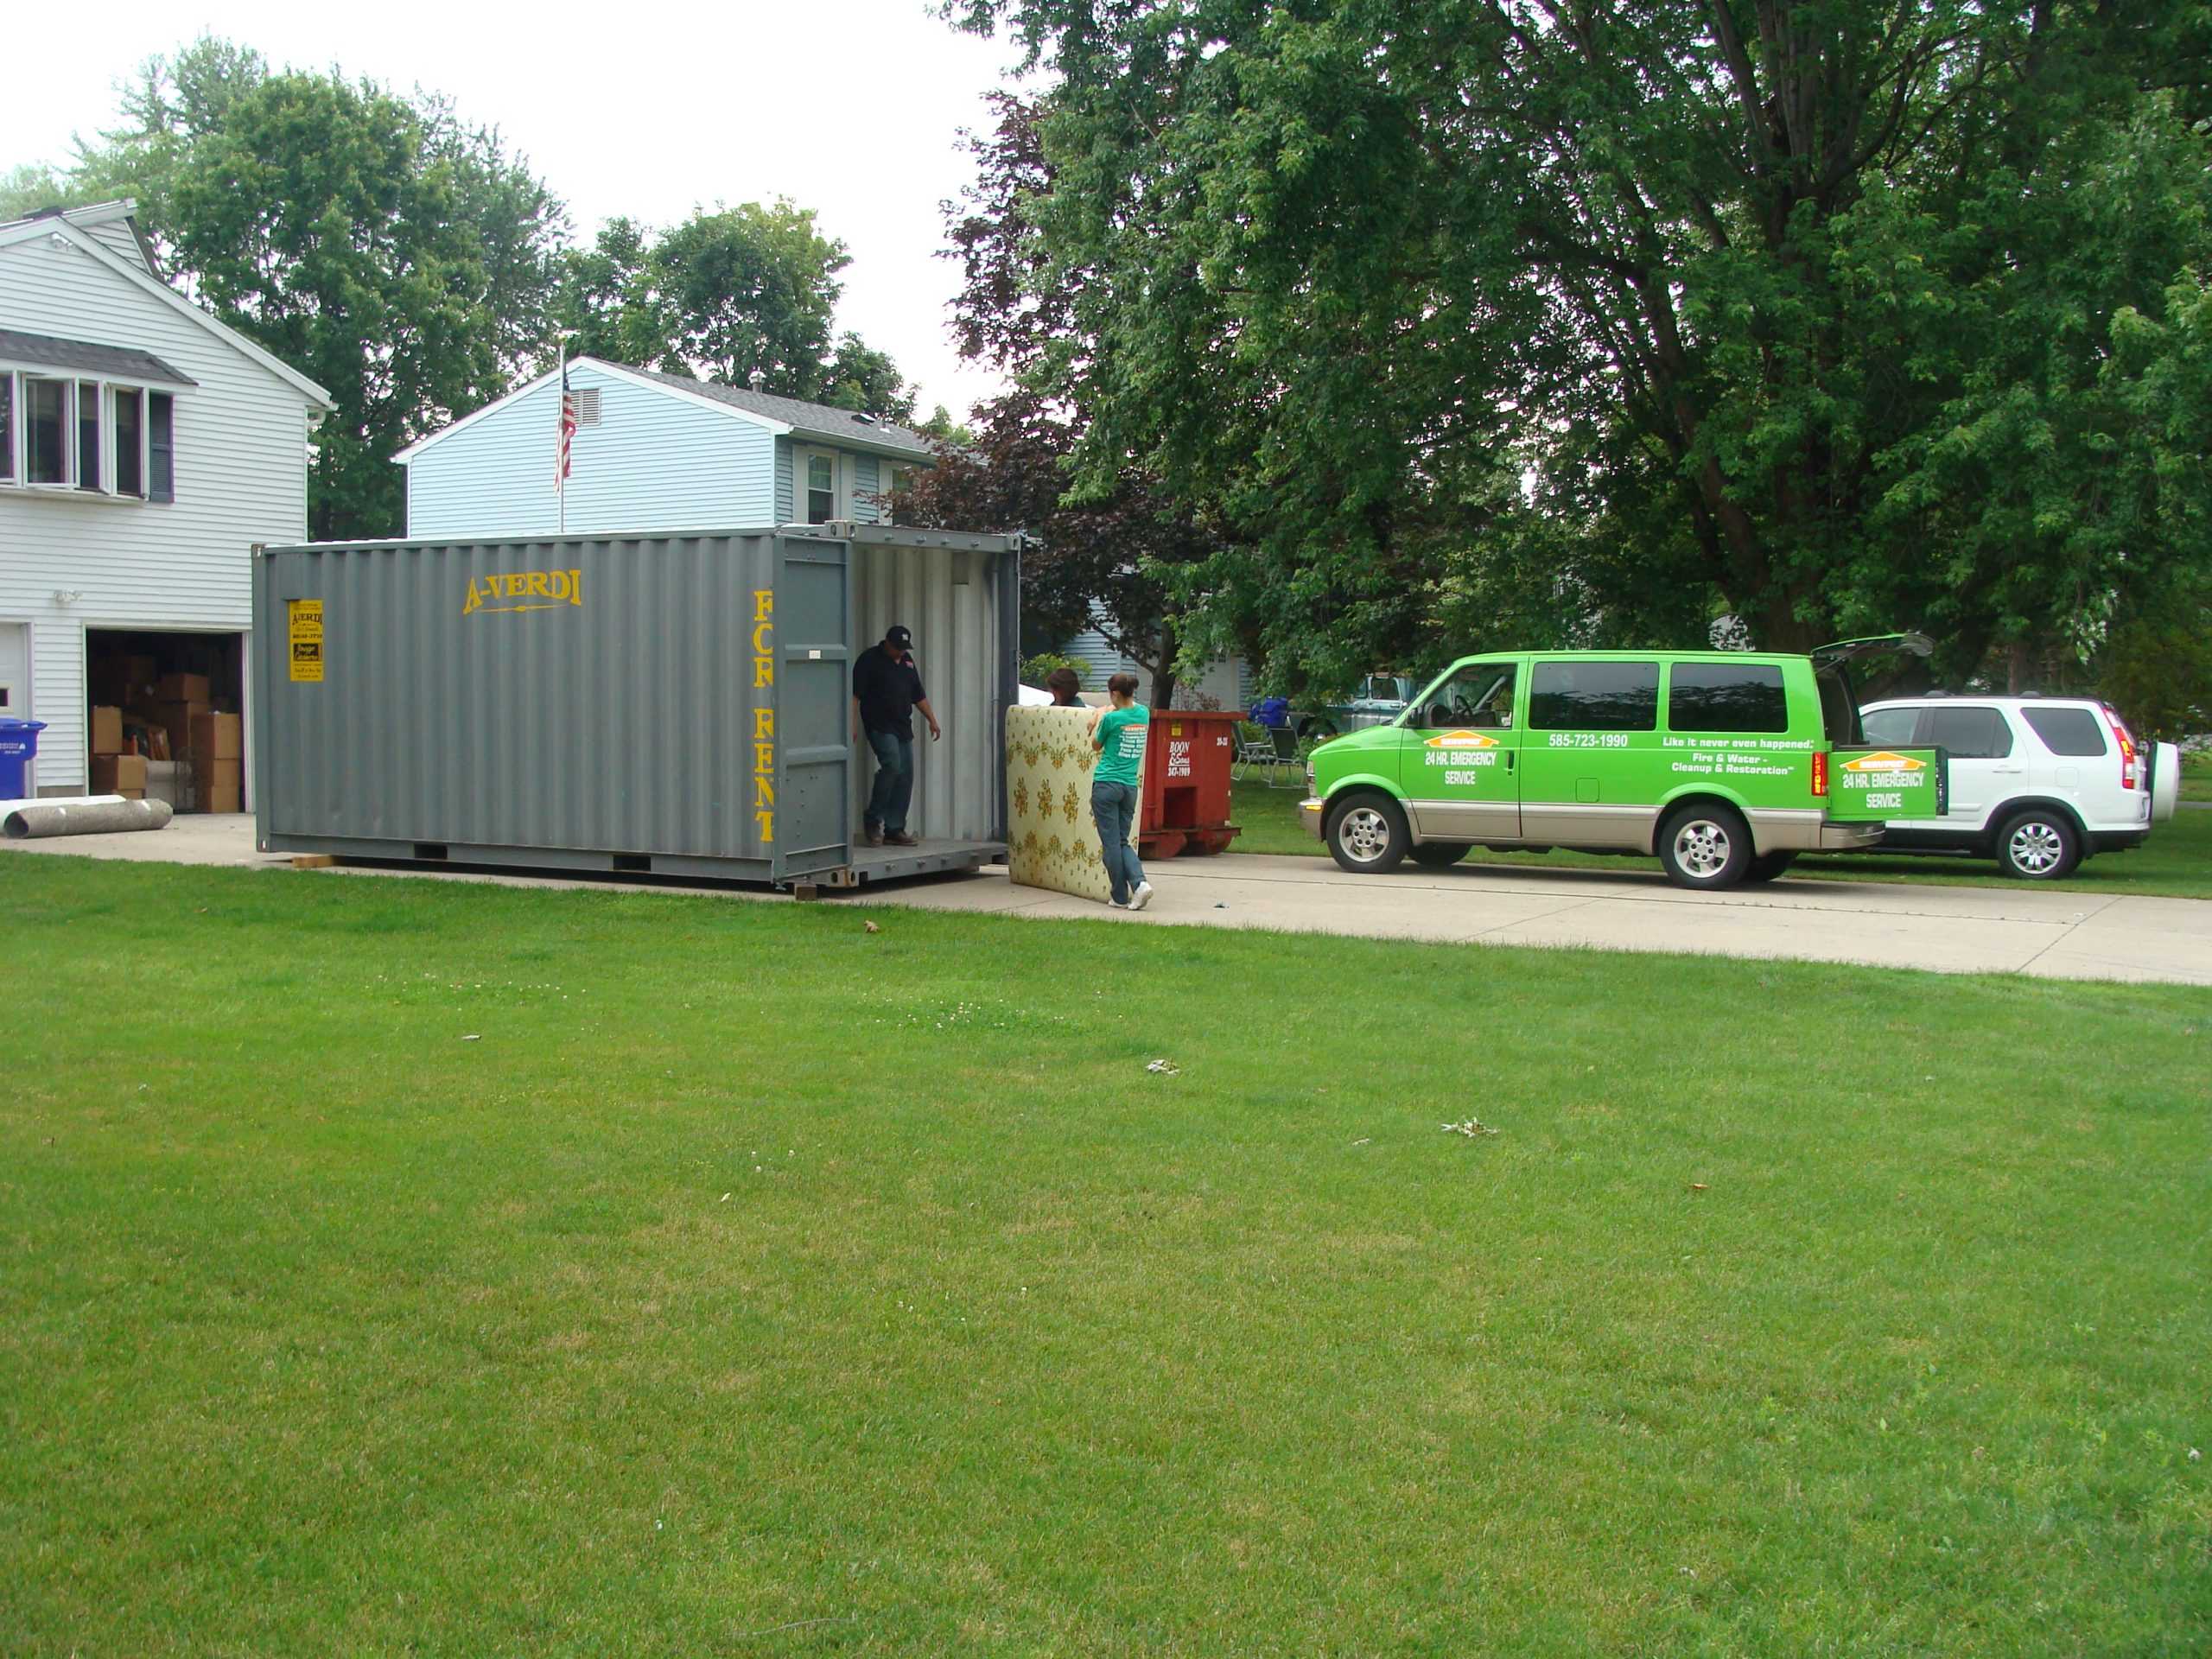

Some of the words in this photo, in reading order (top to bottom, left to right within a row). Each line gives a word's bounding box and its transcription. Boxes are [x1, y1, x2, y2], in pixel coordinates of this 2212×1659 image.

[462, 569, 582, 615] A-VERDI
[1169, 741, 1191, 753] BOON
[1548, 733, 1629, 747] 585-723-1990
[1662, 737, 1684, 747] Like
[1688, 737, 1696, 747] it
[1700, 739, 1730, 747] never
[1732, 739, 1757, 748] even
[1425, 751, 1435, 766] 24
[1451, 751, 1497, 766] EMERGENCY
[1693, 753, 1713, 762] Fire
[1716, 753, 1725, 763] &
[1727, 754, 1761, 764] Water
[753, 708, 774, 843] RENT
[1672, 762, 1712, 774] Cleanup
[1715, 764, 1723, 773] &
[1445, 770, 1476, 785] SERVICE
[1842, 773, 1854, 789] 24
[1872, 772, 1924, 788] EMERGENCY
[1866, 792, 1902, 809] SERVICE
